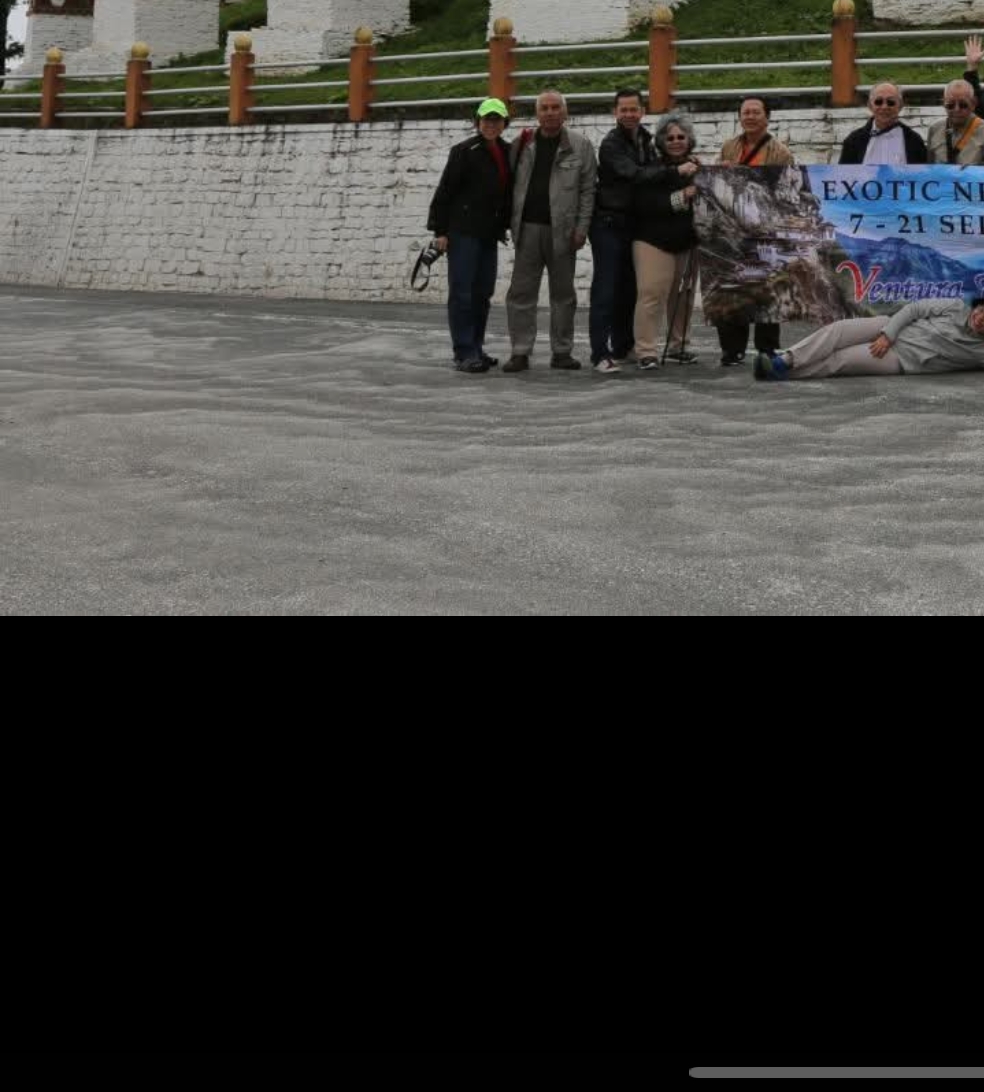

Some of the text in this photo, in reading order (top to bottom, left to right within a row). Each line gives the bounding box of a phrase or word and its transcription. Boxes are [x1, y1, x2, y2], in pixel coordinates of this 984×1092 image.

[822, 180, 941, 201] EXOTIC
[849, 214, 864, 234] 7
[898, 214, 927, 234] 21
[835, 260, 965, 303] Ventura
